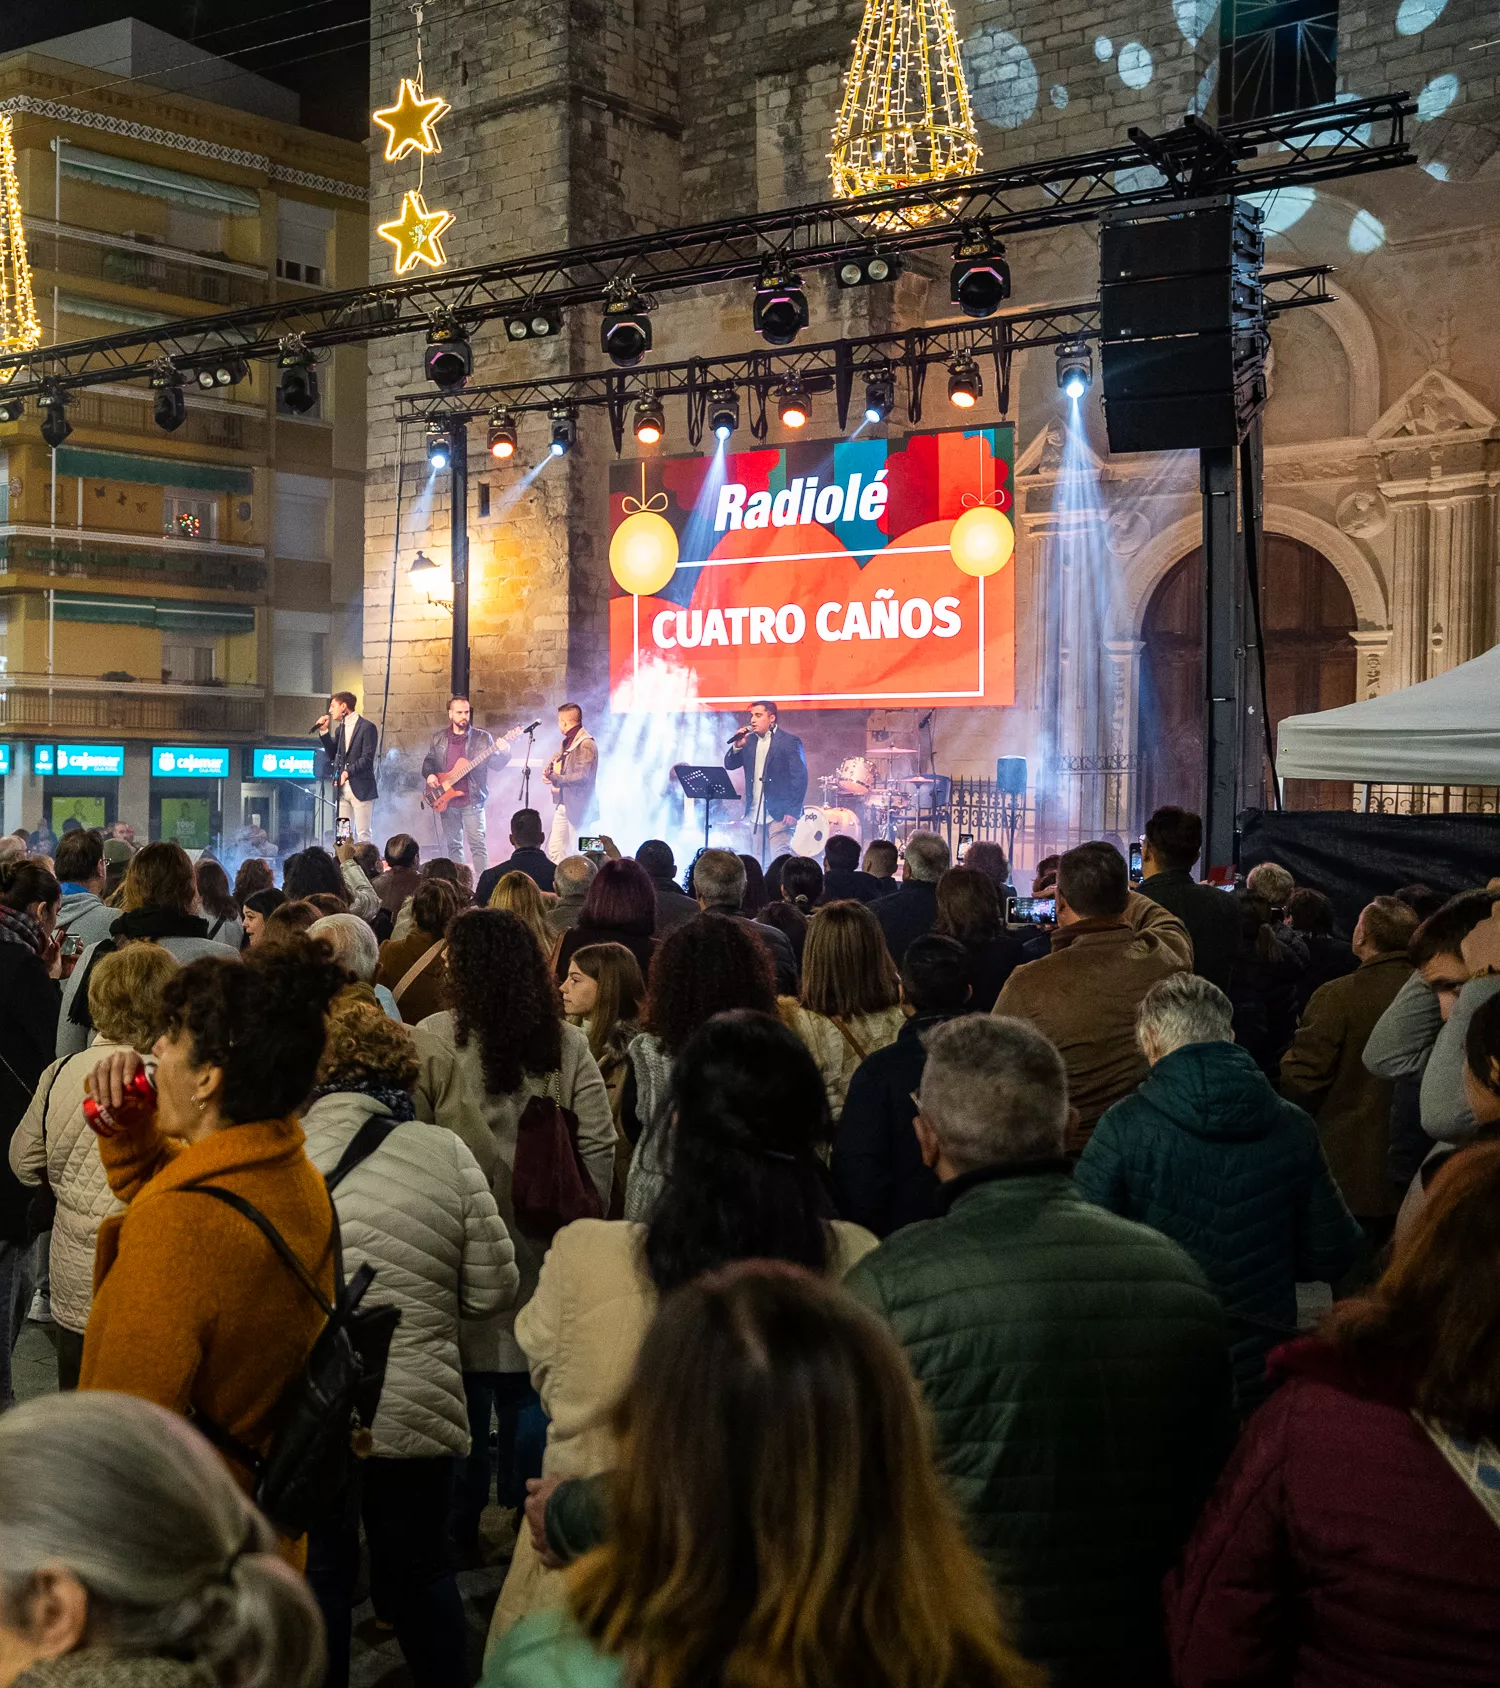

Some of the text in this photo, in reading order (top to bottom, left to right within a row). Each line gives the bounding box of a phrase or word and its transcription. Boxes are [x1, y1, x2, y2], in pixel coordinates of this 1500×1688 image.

[713, 469, 889, 532] Radiolé
[652, 588, 962, 649] CUATRO CAÑOS
[70, 752, 119, 770] cajamar
[177, 754, 223, 771] cajamar
[805, 813, 817, 821] pdp
